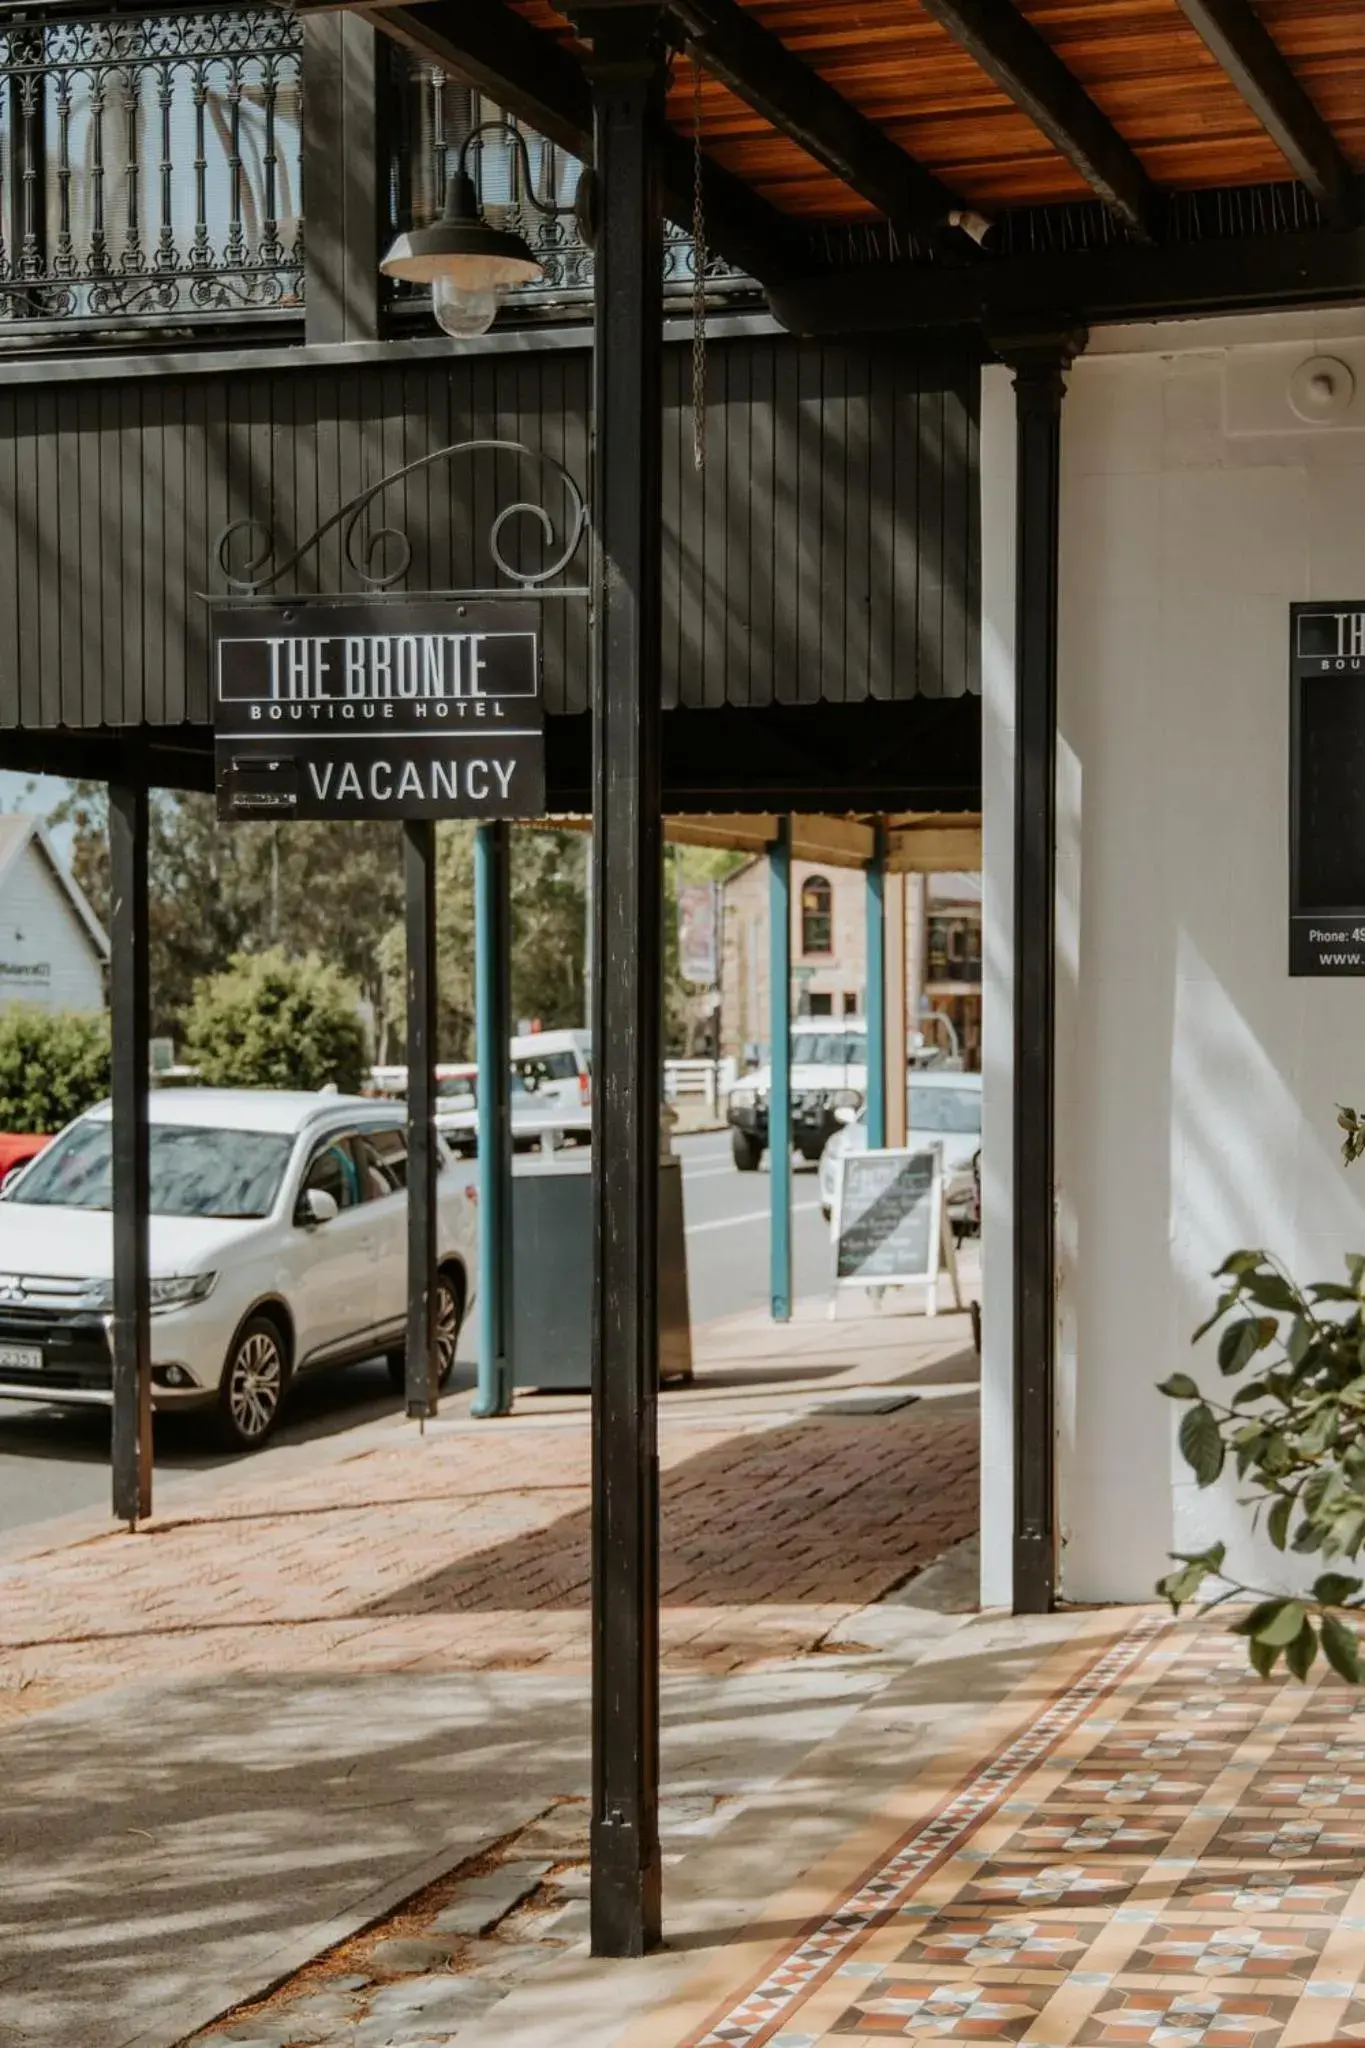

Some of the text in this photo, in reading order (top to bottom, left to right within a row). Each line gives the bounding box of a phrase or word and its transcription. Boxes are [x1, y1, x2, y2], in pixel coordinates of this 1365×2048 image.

[1333, 613, 1365, 656] TH
[266, 635, 487, 700] THE BRONTE
[1321, 659, 1360, 670] BOU
[251, 702, 505, 720] BOUTIQUE HOTEL
[308, 760, 517, 801] VACANCY
[1308, 929, 1350, 943] Phone:
